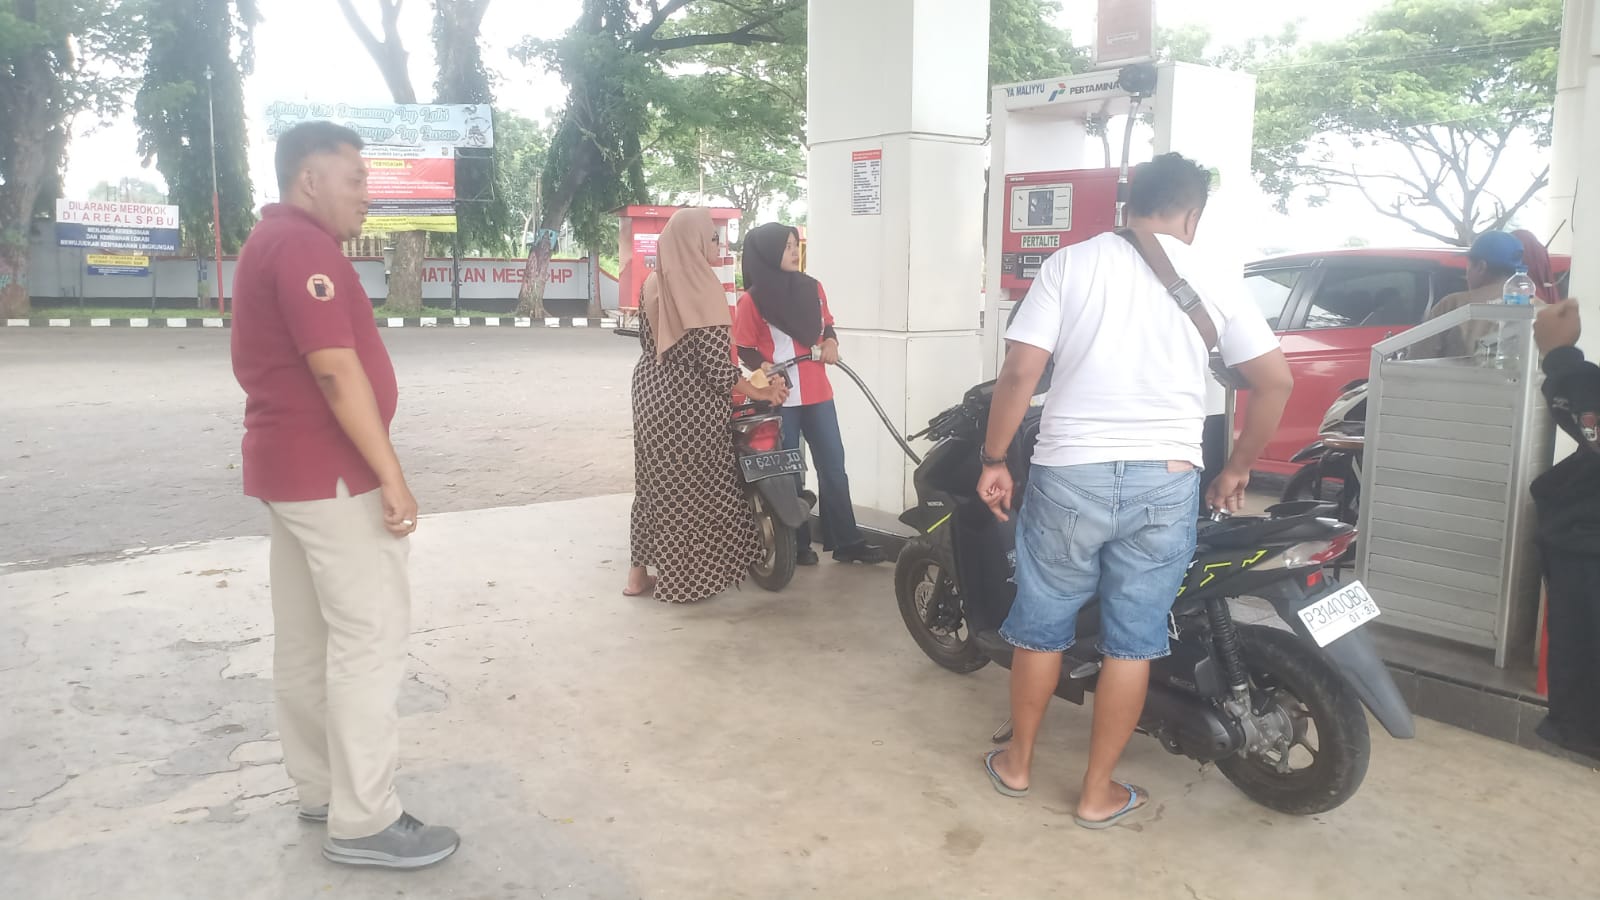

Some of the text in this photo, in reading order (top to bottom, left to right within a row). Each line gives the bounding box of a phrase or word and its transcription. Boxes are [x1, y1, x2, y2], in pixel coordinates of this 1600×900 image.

[1006, 84, 1045, 97] YA MALIYYU
[1069, 82, 1120, 95] PERTAMINA
[68, 200, 166, 214] DILARANG MEROKOK
[62, 211, 175, 226] DI AREAL SPBU
[1022, 236, 1059, 247] PERTALITE
[492, 268, 526, 283] MES
[551, 269, 573, 283] HP
[744, 459, 752, 470] P
